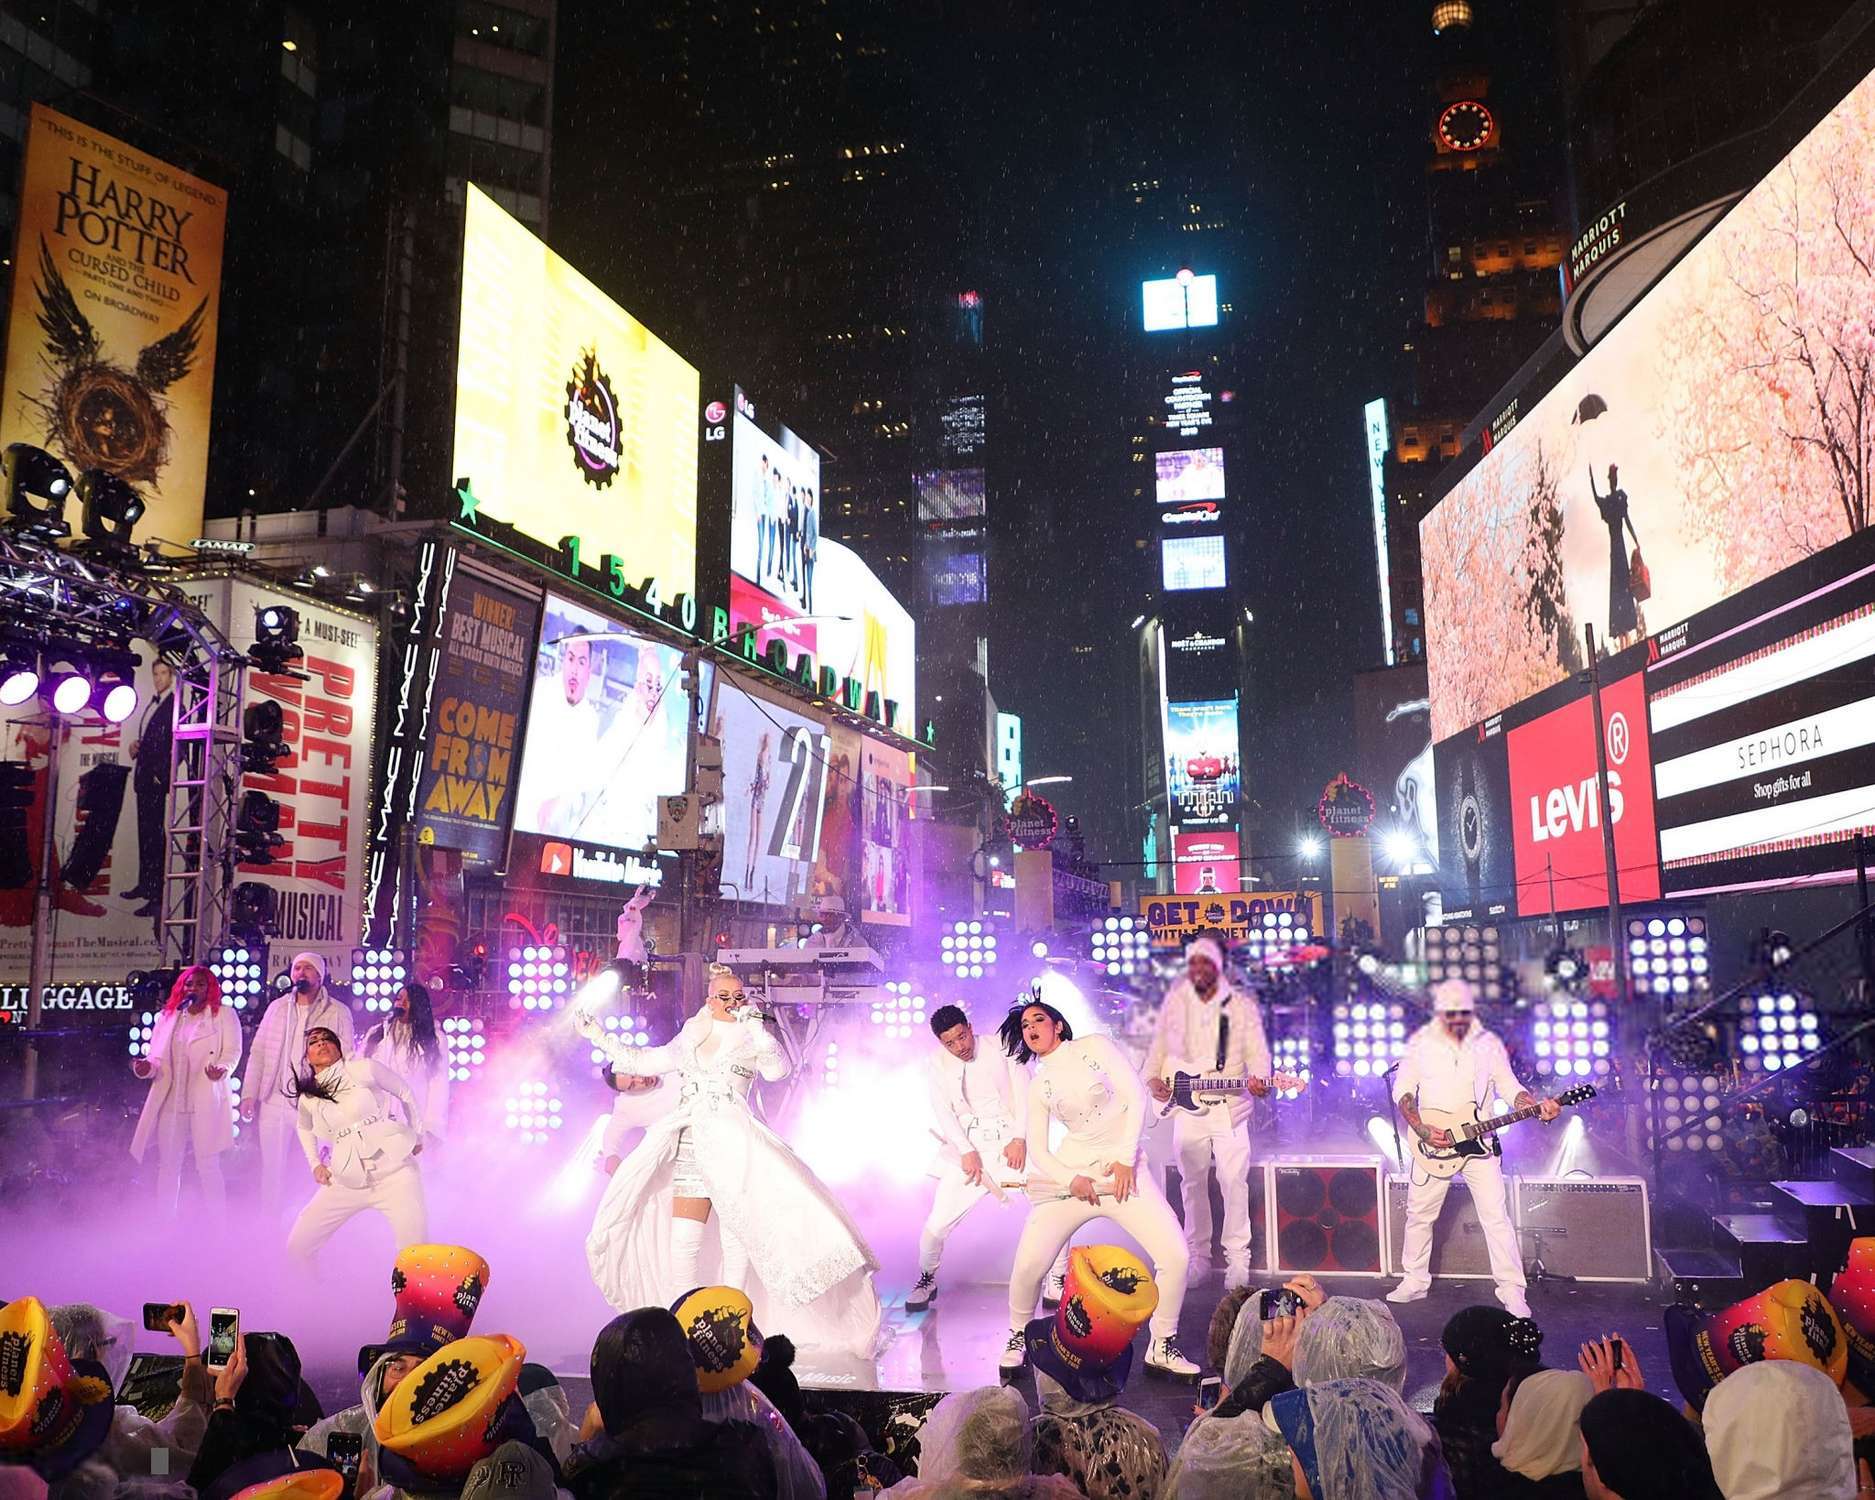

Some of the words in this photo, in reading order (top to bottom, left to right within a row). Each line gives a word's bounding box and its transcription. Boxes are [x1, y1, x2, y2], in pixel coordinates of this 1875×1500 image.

[69, 156, 192, 244] HARRY
[54, 190, 198, 285] POTTER
[1570, 201, 1627, 262] MARRIOTT
[68, 247, 130, 282] CURSED
[133, 274, 181, 302] CHILD
[1572, 228, 1621, 281] MARQUIS
[84, 288, 101, 302] ON
[705, 426, 725, 441] LG
[193, 539, 250, 552] LAMAR
[305, 618, 311, 635] A
[451, 611, 481, 646] BEST
[480, 621, 524, 664] MUSICAL
[558, 535, 696, 630] 1540
[712, 606, 899, 727] BROADWAY
[1659, 622, 1689, 644] MARRIOTT
[1660, 636, 1687, 656] MARQUIS
[438, 697, 516, 749] COME
[1737, 724, 1824, 769] SEPHORA
[295, 656, 355, 890] PRETTY
[1753, 782, 1773, 799] Shop
[1772, 777, 1790, 798] gifts
[1789, 774, 1801, 791] for
[1801, 770, 1812, 786] all
[423, 773, 506, 822] AWAY
[1325, 806, 1361, 817] planet
[1011, 819, 1045, 831] planet
[1015, 826, 1051, 837] fitness
[1148, 901, 1200, 925] GET
[693, 1330, 724, 1371] fitness
[696, 1318, 727, 1358] planet
[11, 1337, 21, 1384] planet
[415, 1368, 459, 1423] fitness
